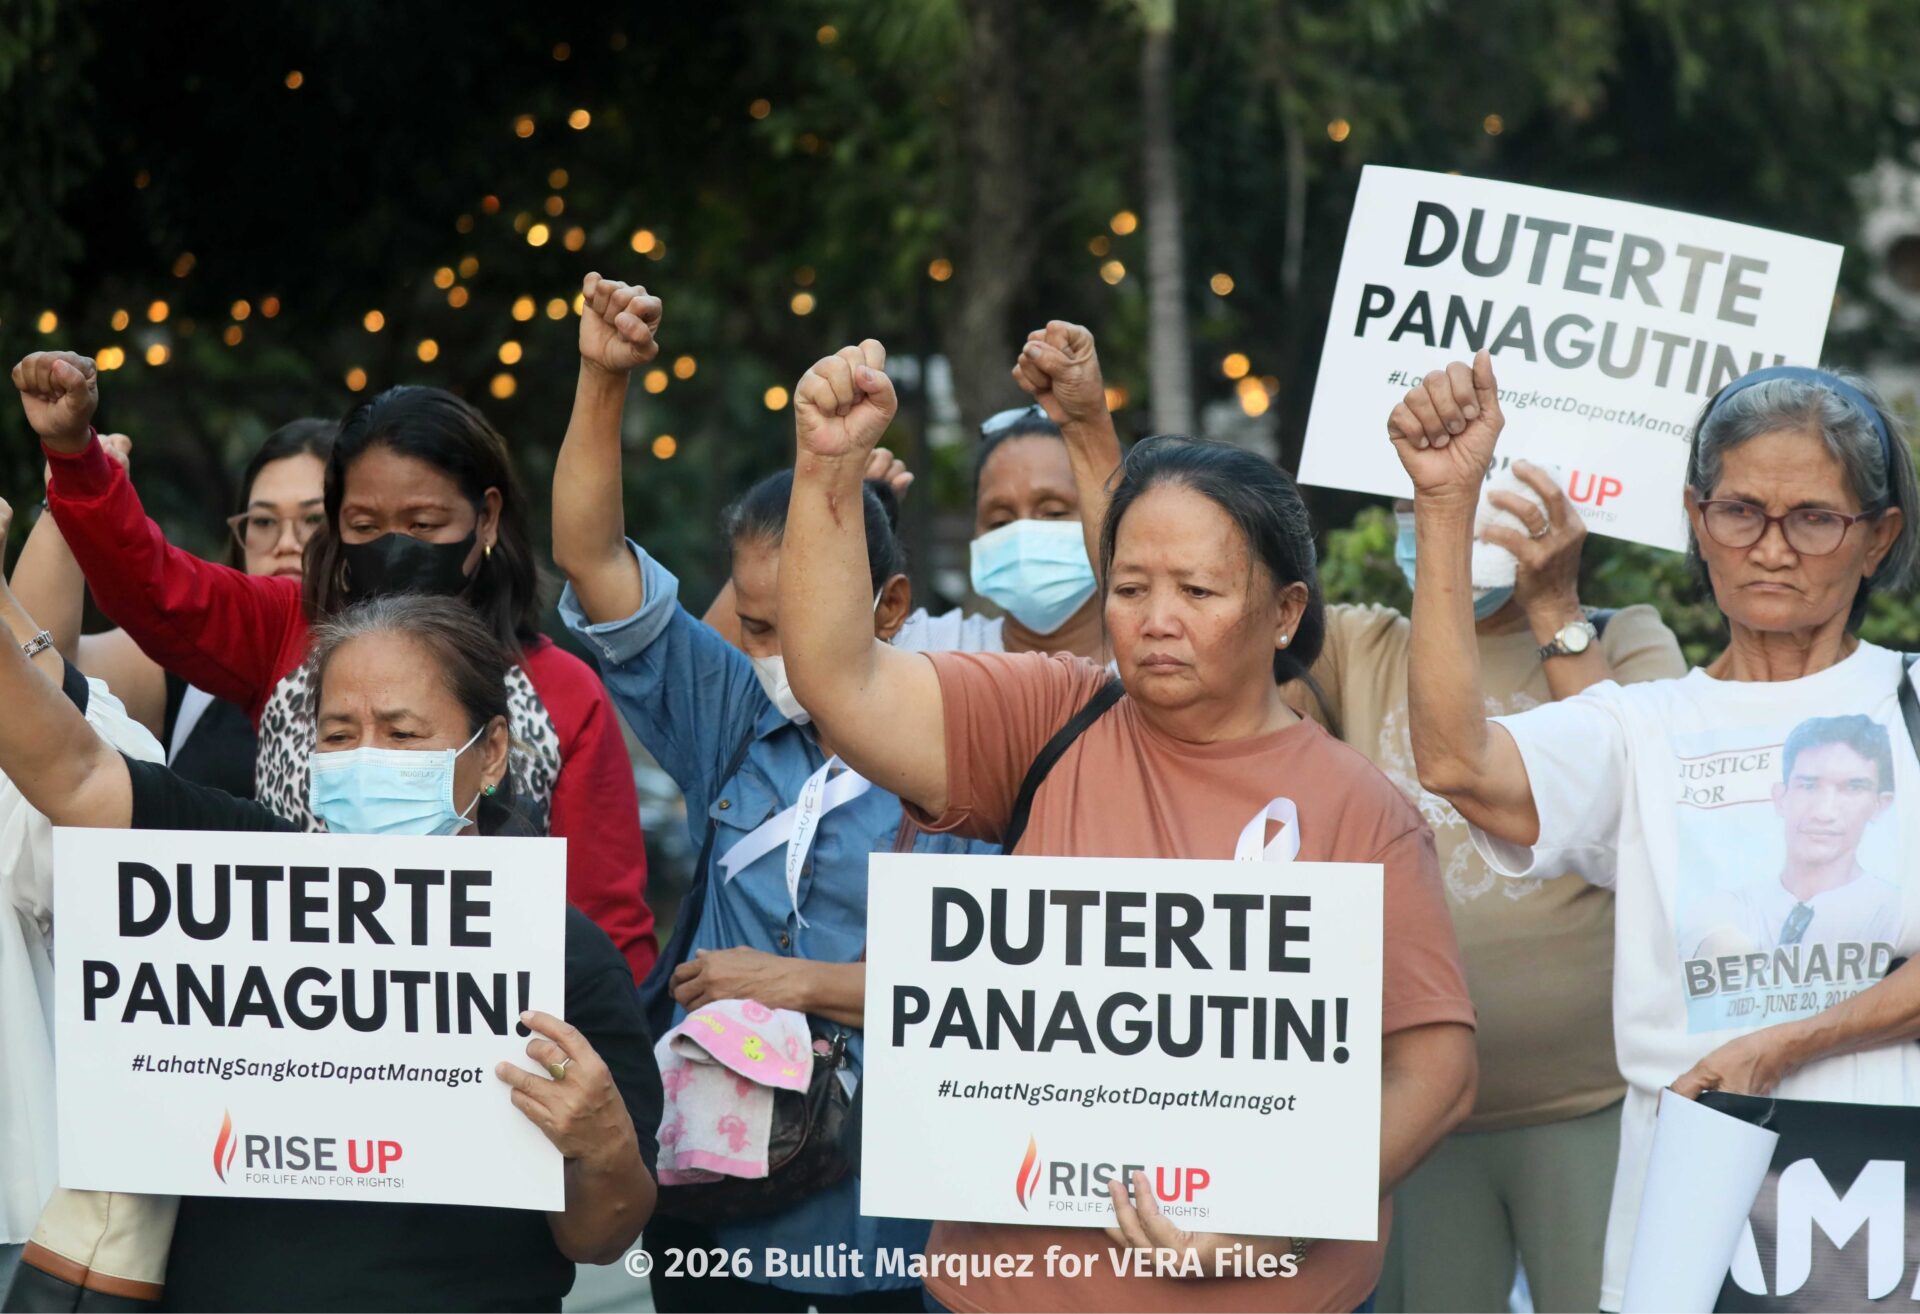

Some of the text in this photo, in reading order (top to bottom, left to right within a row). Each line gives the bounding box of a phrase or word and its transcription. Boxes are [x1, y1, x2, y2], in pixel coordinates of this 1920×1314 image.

[1404, 200, 1770, 328] DUTERTE
[1354, 283, 1786, 399] PANAGUTIN
[1568, 470, 1623, 507] UP
[1678, 752, 1770, 780] JUSTICE
[1682, 784, 1725, 804] FOR
[117, 861, 492, 948] DUTERTE
[930, 886, 1312, 974] DUTERTE
[1684, 941, 1897, 997] BERNARD
[82, 960, 532, 1038] PANAGUTIN!
[1761, 992, 1799, 1019] JUNE
[1799, 991, 1820, 1014] 20,
[891, 984, 1351, 1065] PANAGUTIN!
[131, 1054, 484, 1088] #LahatNgSangkotDapatManagot
[937, 1079, 1298, 1116] #LahatNgSangkotDapatManagot
[245, 1134, 404, 1175] RISE UP
[245, 1172, 405, 1188] FOR LIFE AND FOR RIGHTS!
[1155, 1166, 1211, 1203] UP
[1048, 1200, 1073, 1211] FOR
[1077, 1202, 1103, 1213] LIFE
[1163, 1205, 1210, 1218] RIGHTS!
